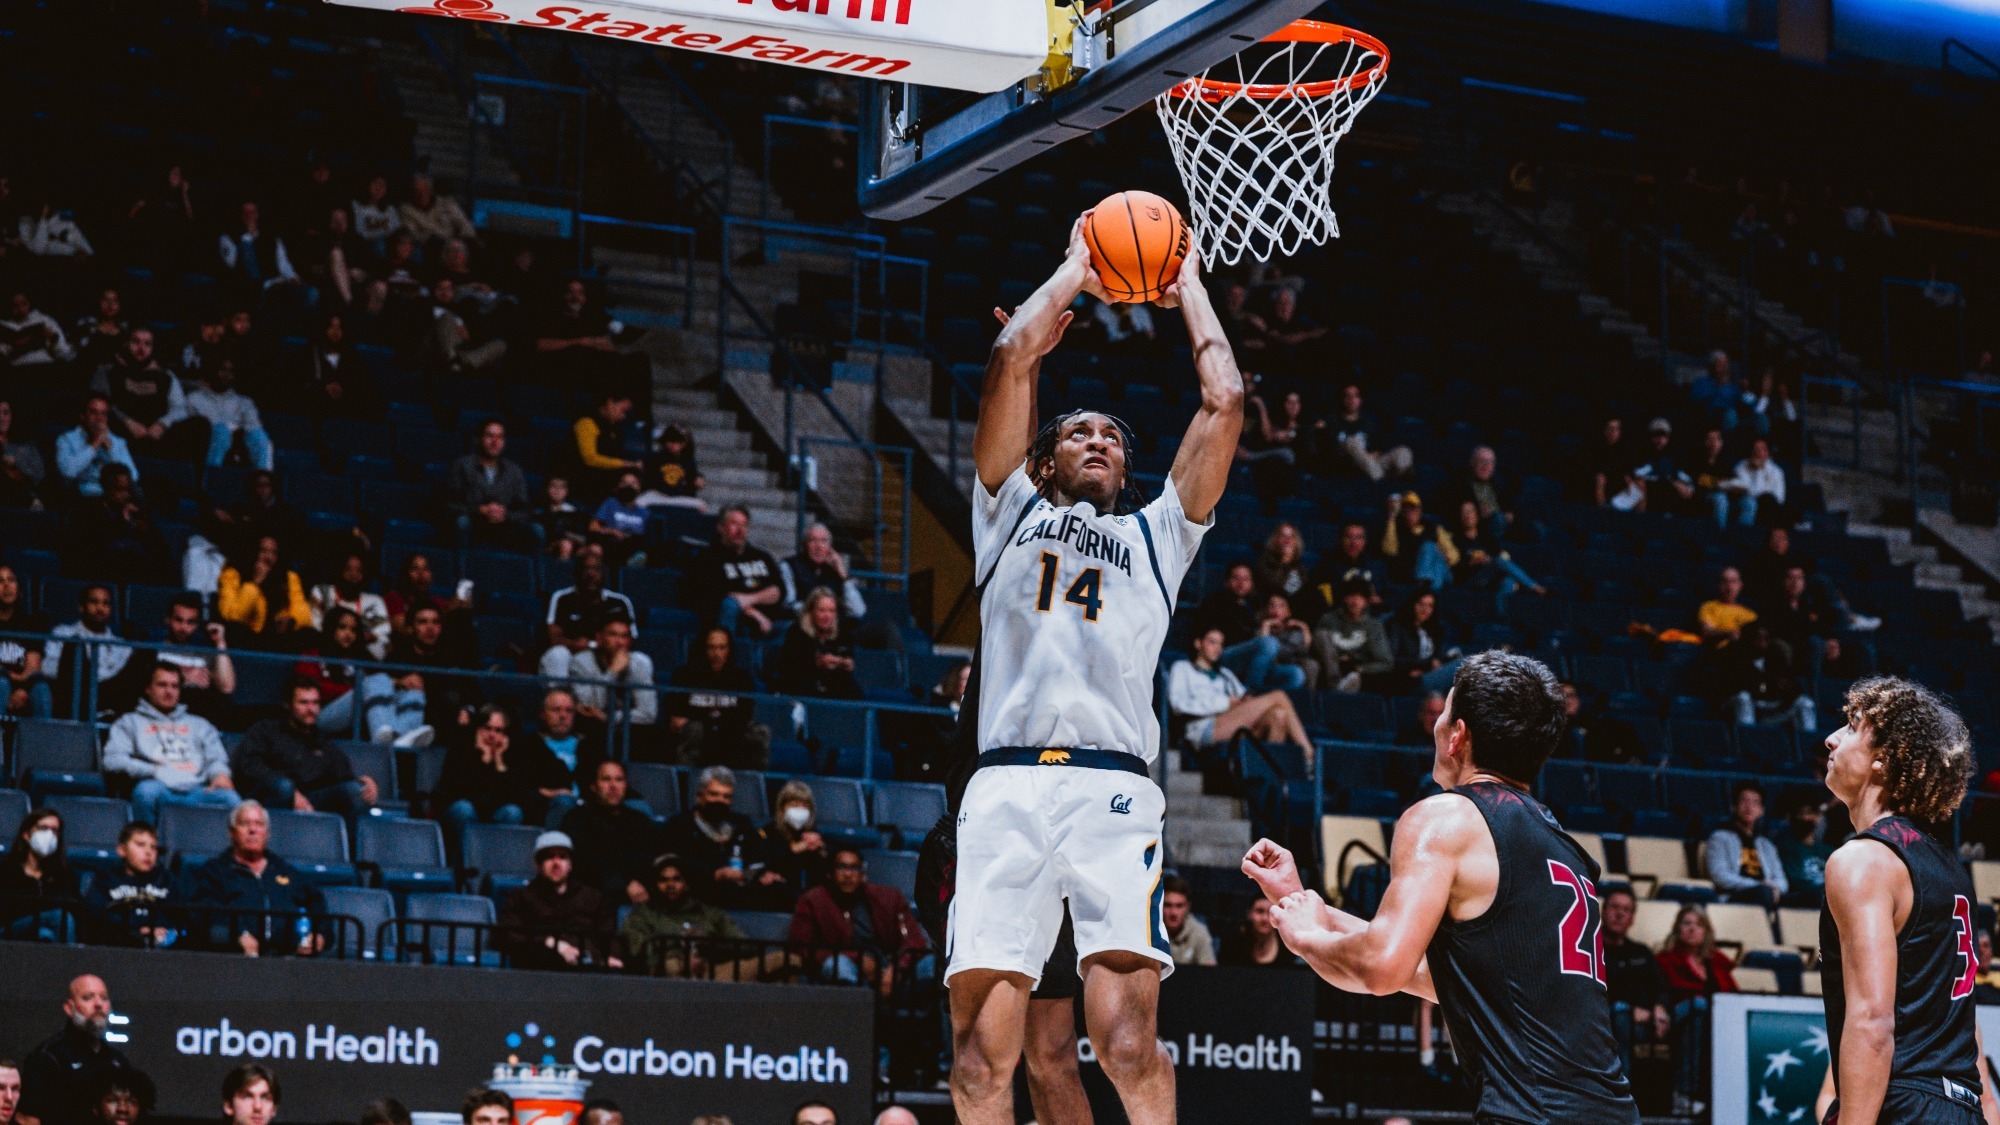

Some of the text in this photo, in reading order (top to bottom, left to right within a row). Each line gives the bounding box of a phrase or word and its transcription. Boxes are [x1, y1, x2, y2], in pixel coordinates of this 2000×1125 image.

[1016, 514, 1131, 578] CALIFORNIA
[1035, 549, 1104, 624] 14
[1110, 793, 1133, 815] Cal
[176, 1017, 440, 1066] arbon Health
[573, 1035, 849, 1084] Carbon Health
[1187, 1032, 1301, 1071] Health
